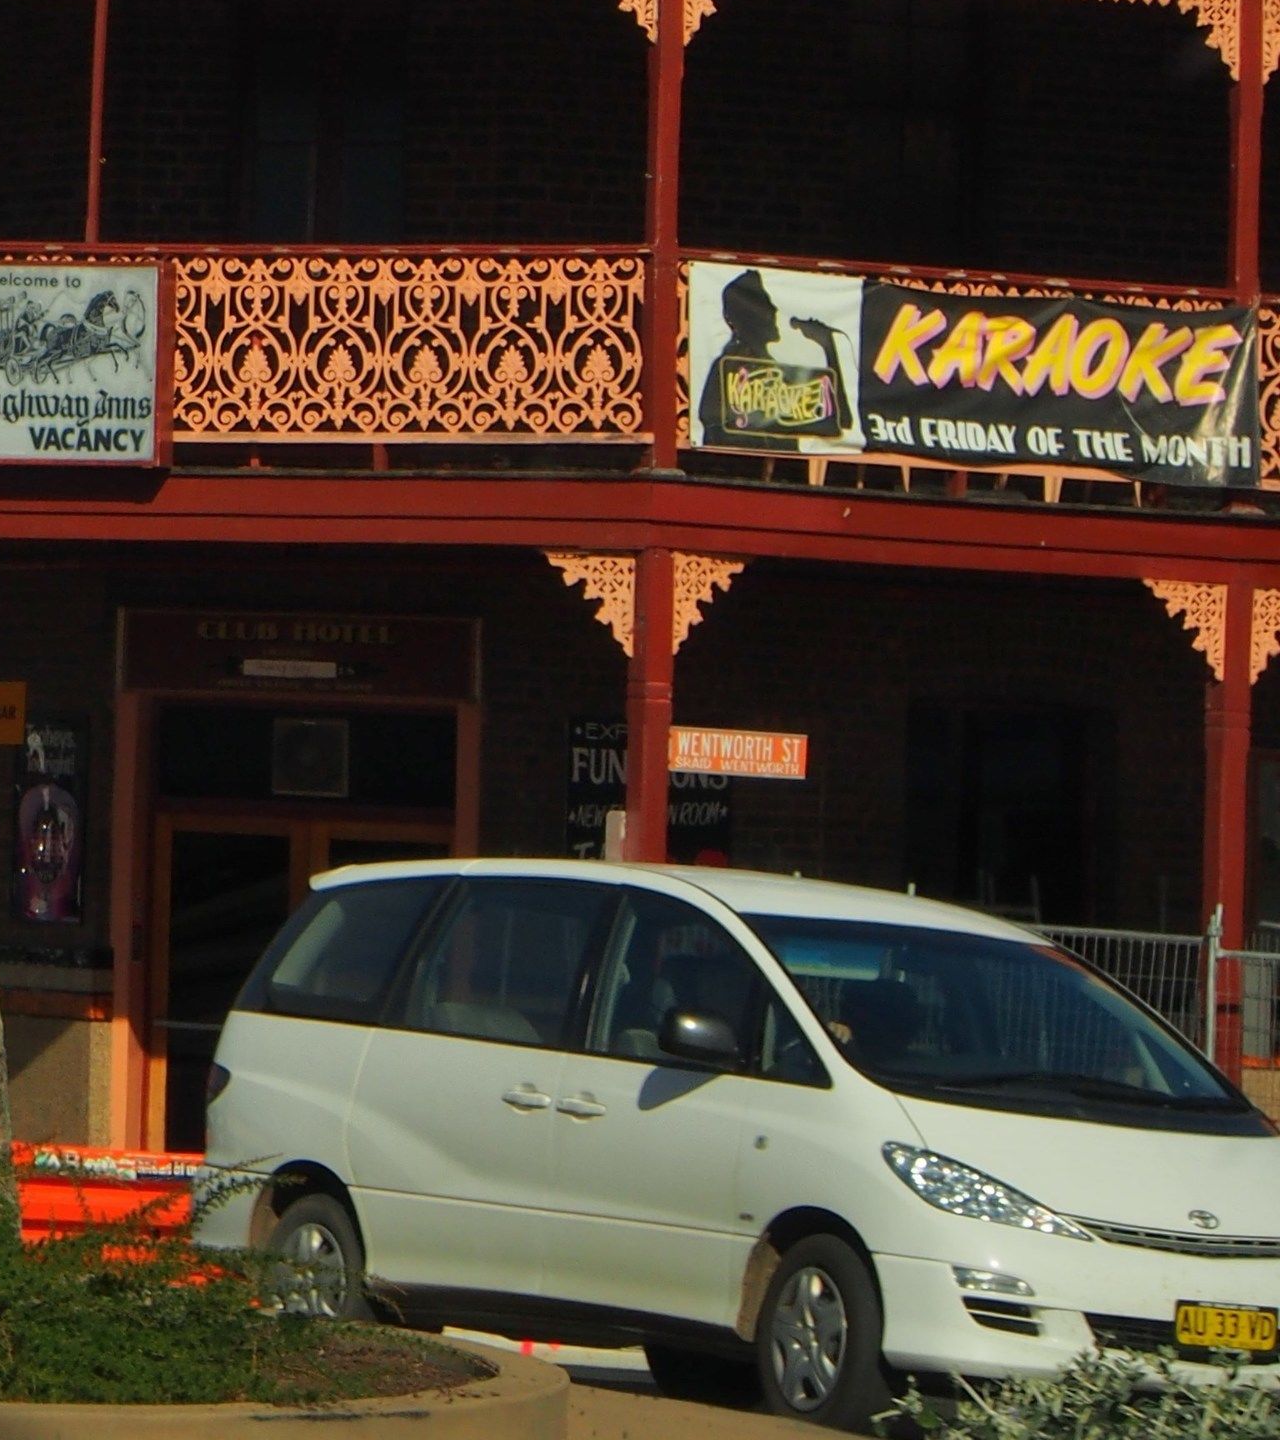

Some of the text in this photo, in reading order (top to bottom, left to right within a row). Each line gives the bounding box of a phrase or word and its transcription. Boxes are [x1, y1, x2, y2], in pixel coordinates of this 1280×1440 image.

[65, 275, 82, 288] to
[873, 303, 1243, 407] KARAOKE
[92, 388, 152, 420] Inns
[727, 370, 817, 421] KARAOKE
[29, 426, 146, 453] VACANCY
[867, 413, 1252, 469] 3rd FRIDAY OF THE MONTH
[678, 731, 801, 764] WENTWORTH ST
[719, 759, 800, 775] WENTWORTH
[1180, 1309, 1208, 1336] AU
[1215, 1311, 1240, 1338] 33
